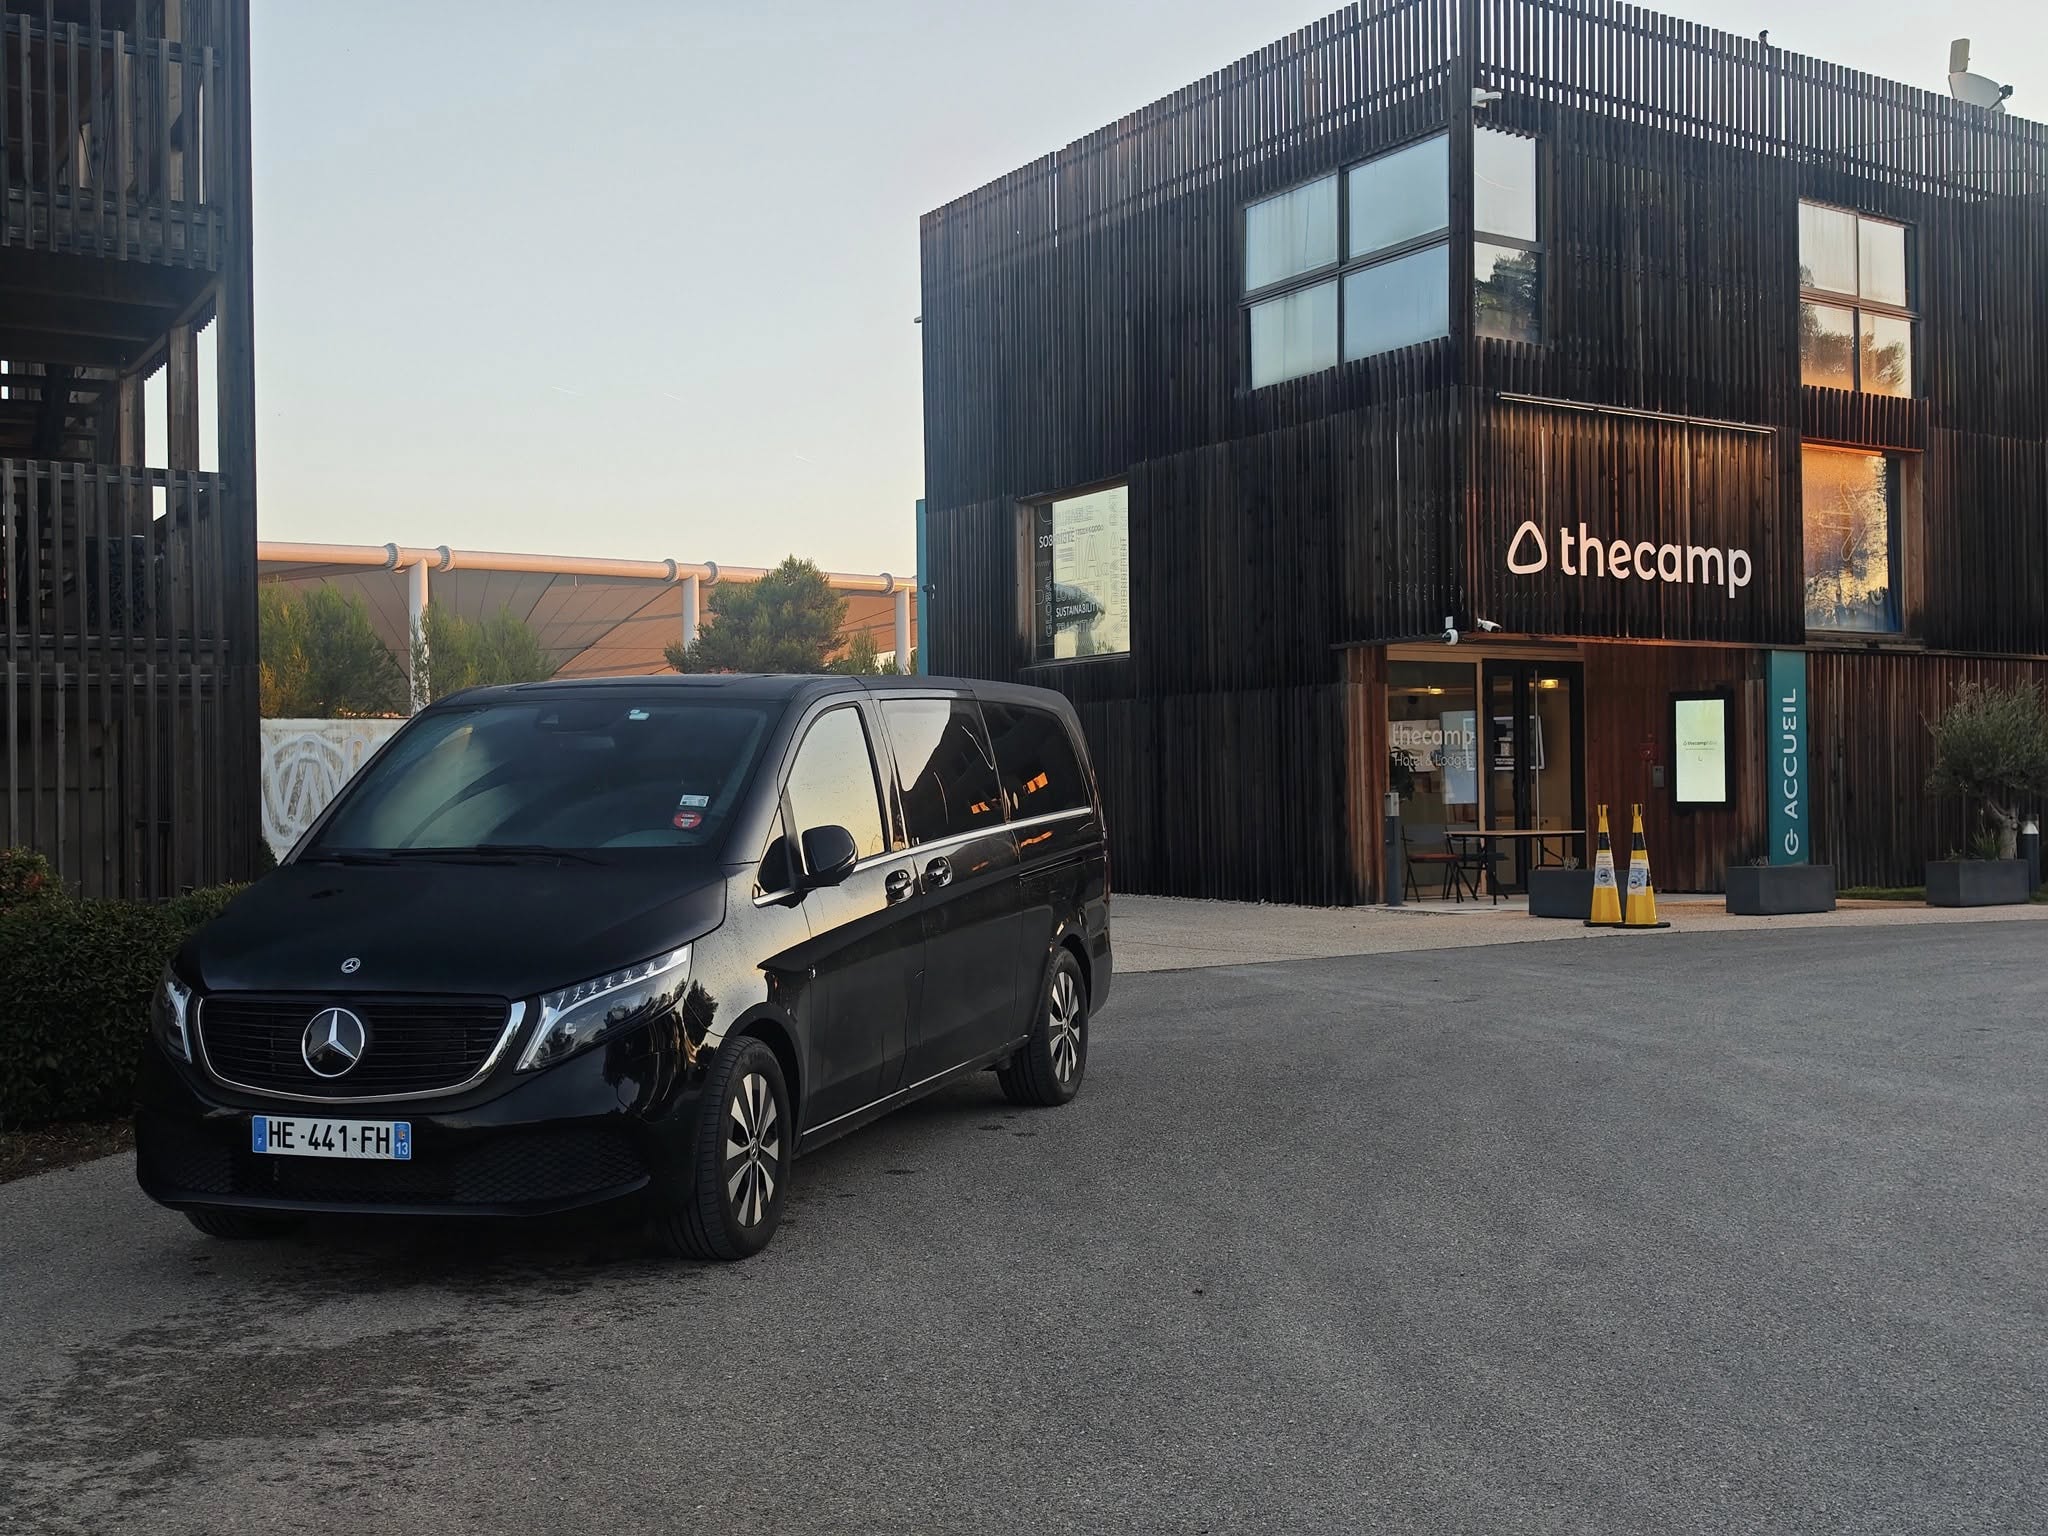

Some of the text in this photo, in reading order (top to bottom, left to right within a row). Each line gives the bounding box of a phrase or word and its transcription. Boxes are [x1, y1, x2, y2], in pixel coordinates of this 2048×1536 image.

[1560, 521, 1752, 599] thecamp
[1392, 723, 1473, 750] thecamp
[1783, 688, 1799, 819] ACCUEIL
[268, 1120, 390, 1154] HE-441-FH
[395, 1142, 409, 1156] 13
